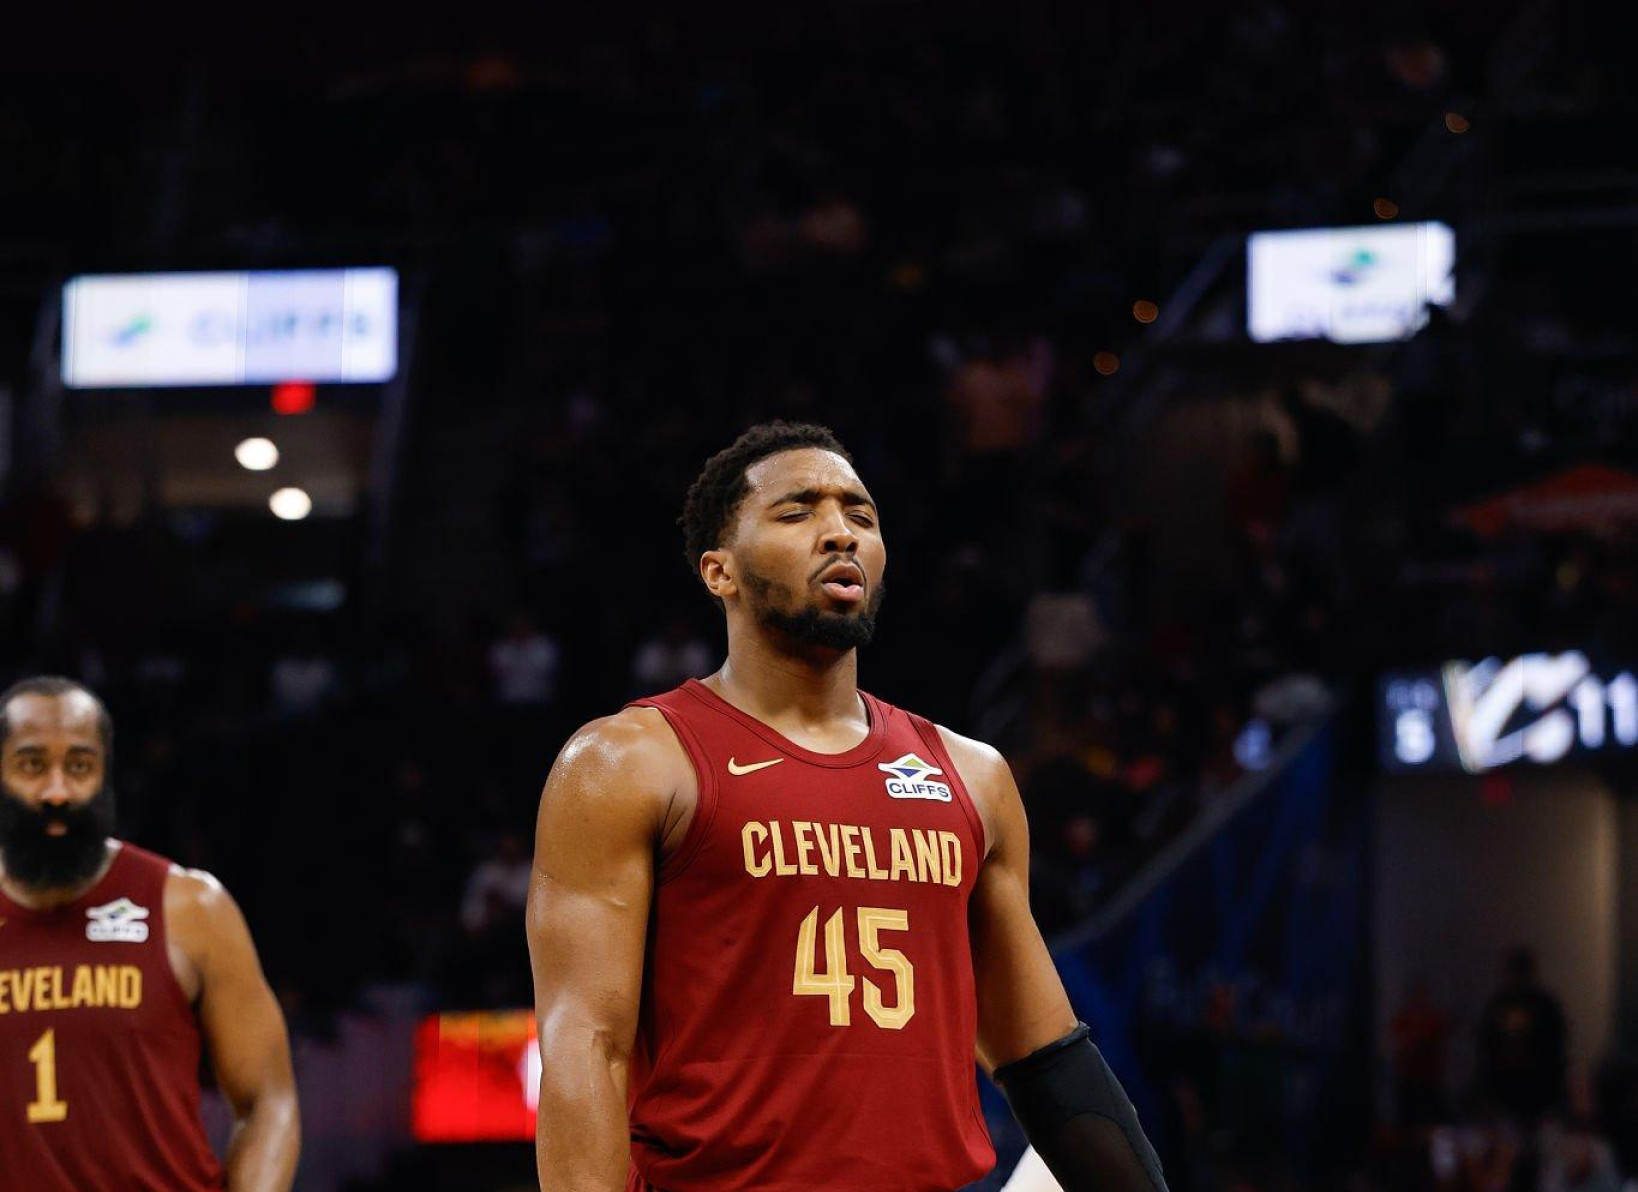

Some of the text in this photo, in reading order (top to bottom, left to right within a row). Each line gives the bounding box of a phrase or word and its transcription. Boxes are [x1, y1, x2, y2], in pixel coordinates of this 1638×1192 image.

[888, 782, 949, 798] CLIFFS
[741, 821, 962, 887] CLEVELAND
[793, 905, 915, 1030] 45
[28, 1028, 68, 1123] 1
